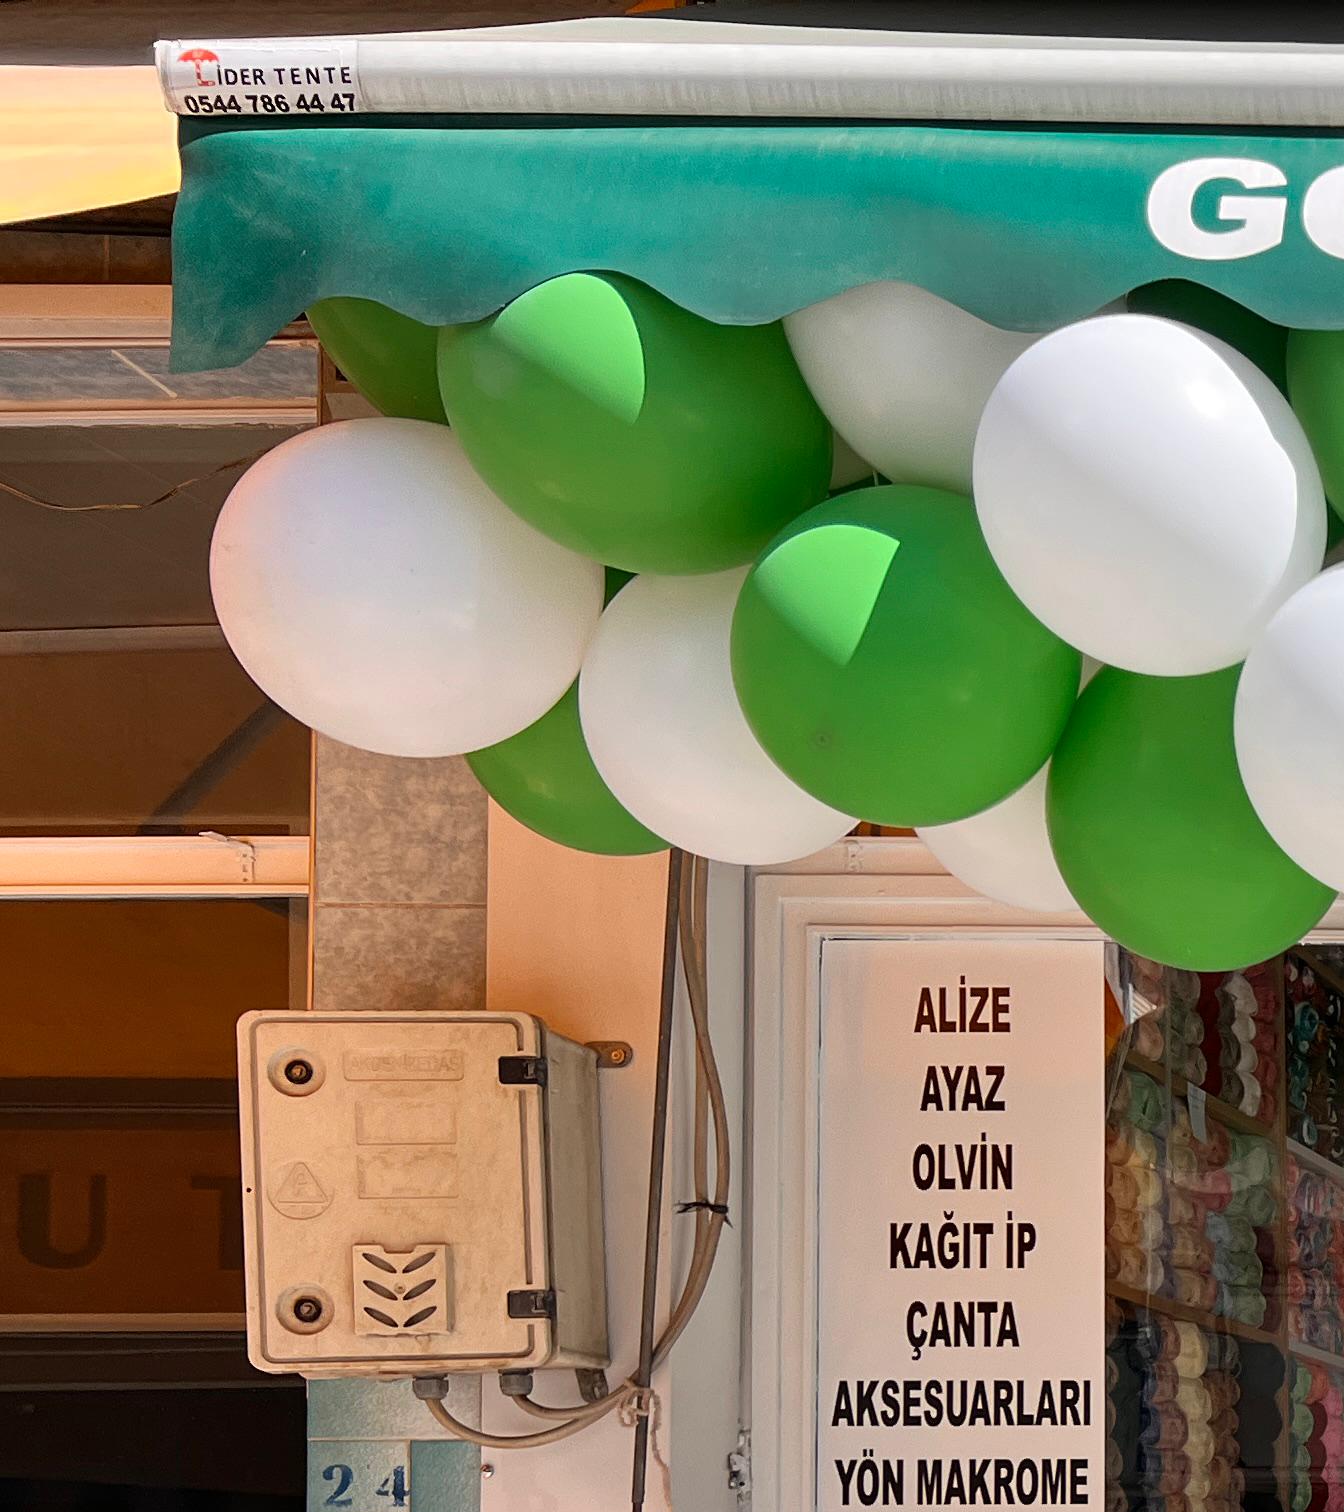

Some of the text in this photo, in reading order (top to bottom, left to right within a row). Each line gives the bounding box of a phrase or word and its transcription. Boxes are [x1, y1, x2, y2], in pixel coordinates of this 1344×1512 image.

[184, 93, 355, 113] 0544 786 44 47
[274, 67, 352, 85] TENTE
[914, 975, 1011, 1033] ALİZE
[920, 1065, 1006, 1112] AYAZ
[912, 1132, 1013, 1190] OLVİN
[889, 1211, 1037, 1269] KAĞIT İP
[906, 1301, 1020, 1360] ÇANTA
[831, 1379, 1091, 1427] AKSESUARLARI
[834, 1449, 1089, 1505] YÖN MAKROME
